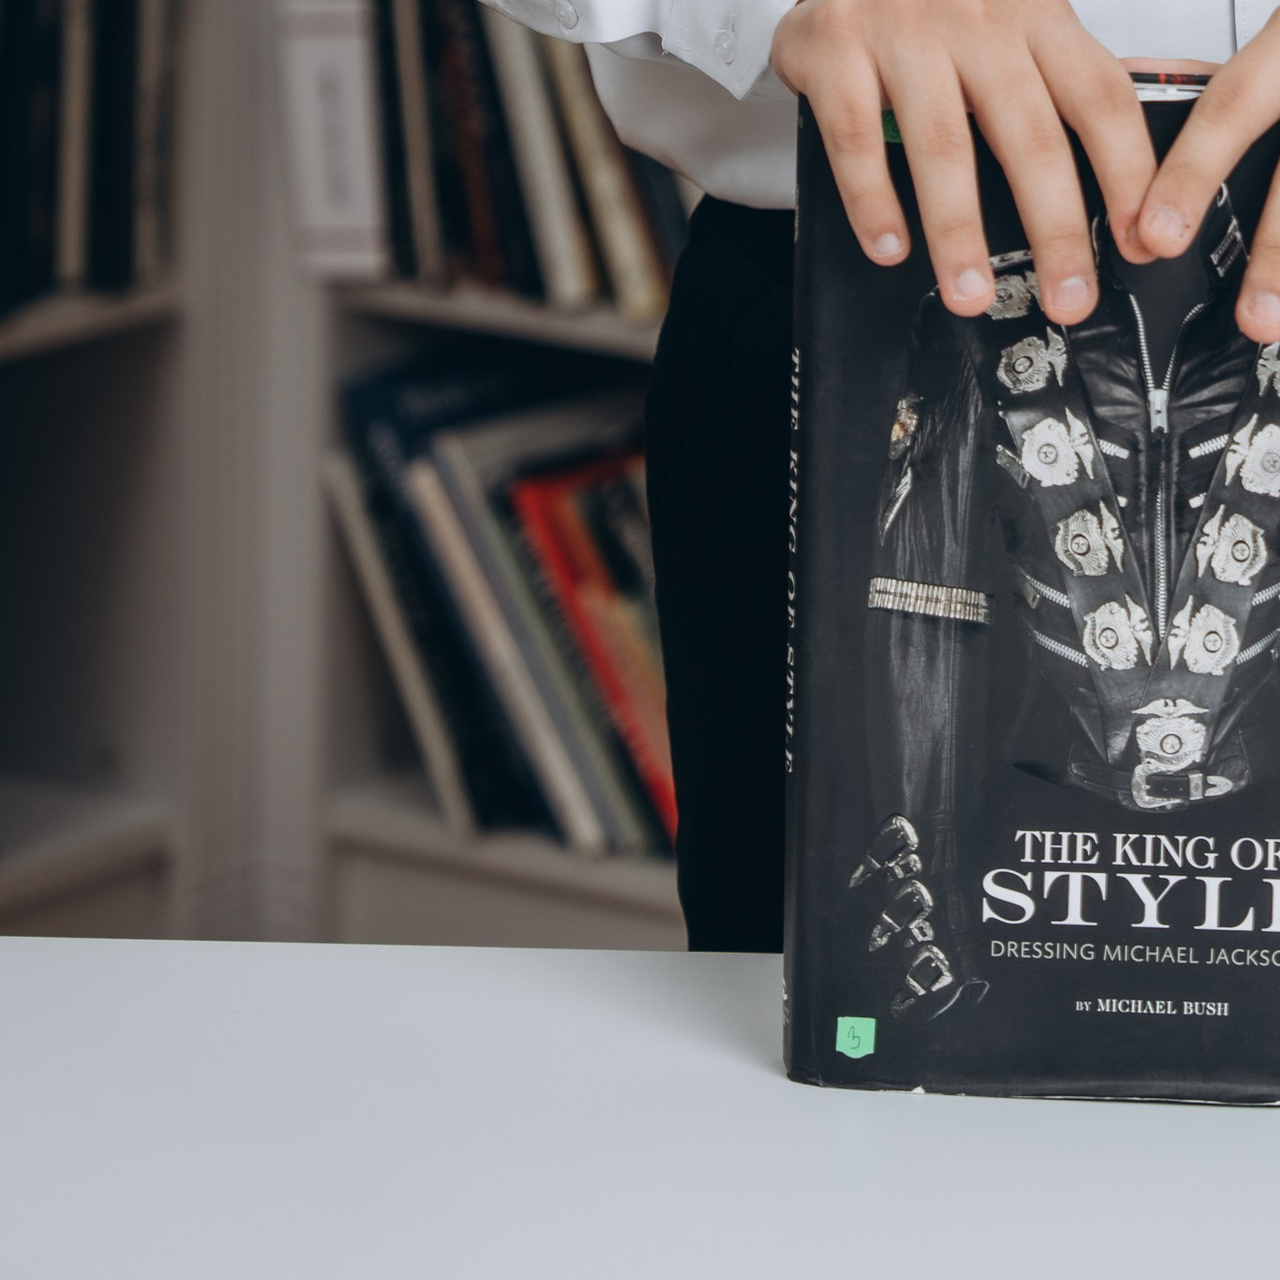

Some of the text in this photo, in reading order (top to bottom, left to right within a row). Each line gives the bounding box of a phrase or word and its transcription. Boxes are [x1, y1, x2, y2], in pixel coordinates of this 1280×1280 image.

[1014, 829, 1100, 865] THE
[1111, 833, 1219, 870] KING
[990, 939, 1096, 962] DRESSING
[1103, 944, 1200, 965] MICHAEL
[1075, 998, 1230, 1017] BY MICHAEL BUSH
